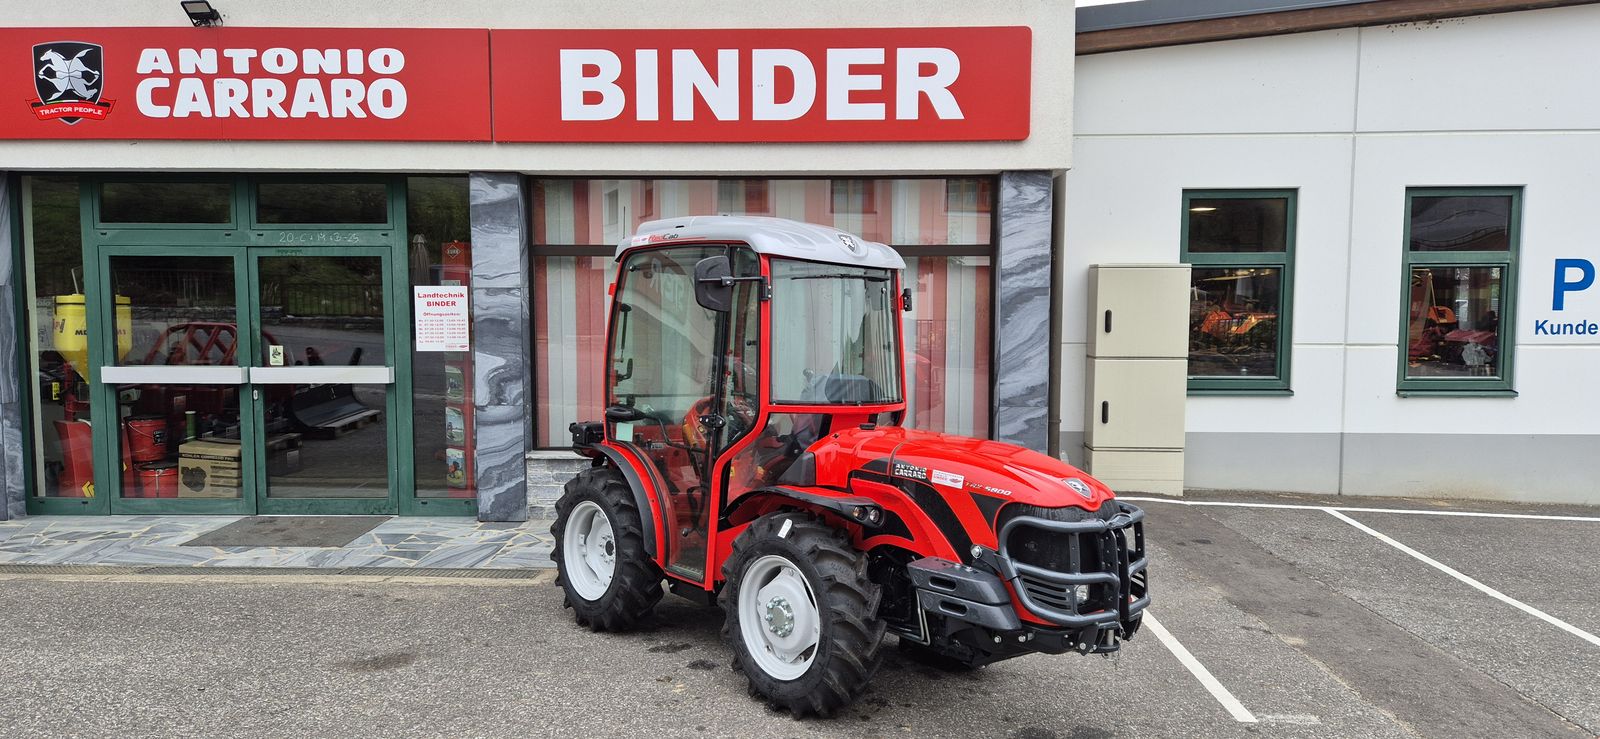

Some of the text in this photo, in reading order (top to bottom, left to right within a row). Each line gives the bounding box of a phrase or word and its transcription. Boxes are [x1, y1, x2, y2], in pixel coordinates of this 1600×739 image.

[136, 47, 406, 75] ANTONIO
[559, 47, 965, 122] BINDER
[135, 77, 408, 120] CARRARO
[40, 106, 103, 116] TRACTOR PEOPLE
[1552, 258, 1596, 311] P
[1534, 319, 1599, 335] Kunde
[894, 468, 927, 479] CARRARO
[895, 463, 928, 473] ANTONIO
